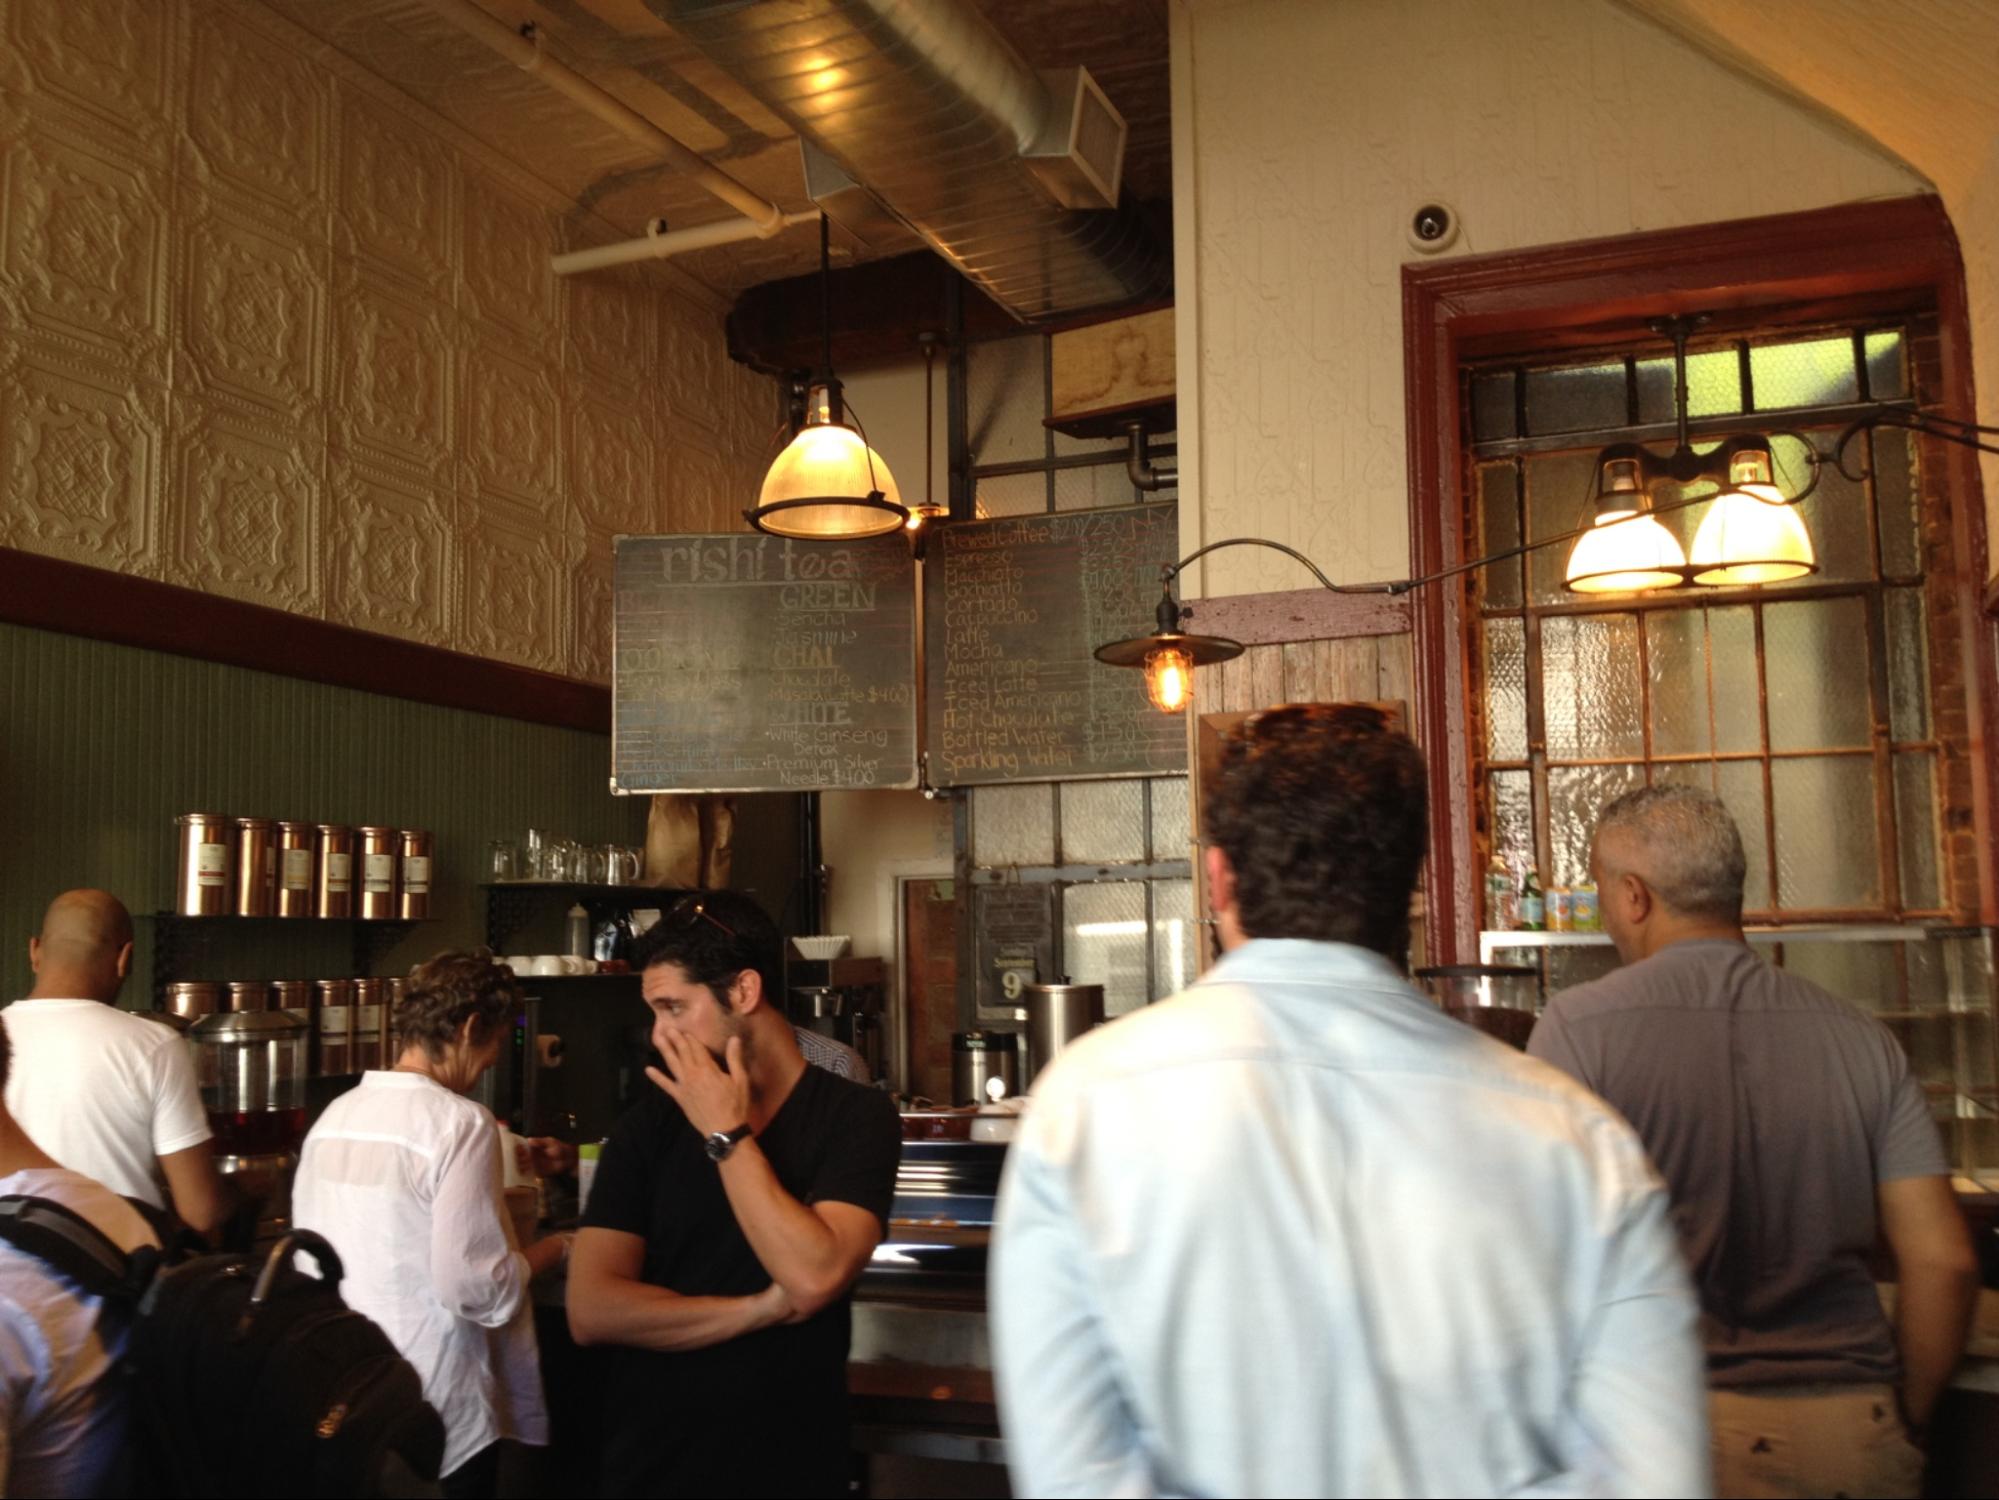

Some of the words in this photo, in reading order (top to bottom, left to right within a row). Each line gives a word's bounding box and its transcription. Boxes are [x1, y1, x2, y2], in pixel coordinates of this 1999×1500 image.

[660, 537, 769, 582] rishi
[779, 538, 854, 582] tea
[779, 583, 877, 609] GREEN
[944, 595, 1018, 614] Cortado
[946, 626, 990, 645] Latte
[773, 646, 833, 668] CHAI
[944, 641, 1004, 660] Mocha
[945, 658, 1039, 678] Americano
[944, 677, 988, 694] Iced
[994, 677, 1038, 694] Latte
[944, 692, 990, 711] Iced
[994, 690, 1082, 709] Americano
[768, 701, 853, 723] WHITE
[943, 709, 973, 729] Hot
[980, 706, 1075, 728] Chocolate
[769, 726, 809, 742] White
[815, 727, 888, 748] Ginseng
[942, 726, 1009, 749] Bottled
[1012, 727, 1066, 746] Water
[793, 742, 838, 756] Detox
[767, 754, 839, 771] Premium
[844, 753, 884, 770] Silver
[942, 747, 1019, 777] Sparkling
[1027, 746, 1073, 768] Water
[780, 767, 829, 785] Needle
[1002, 971, 1021, 999] 9
